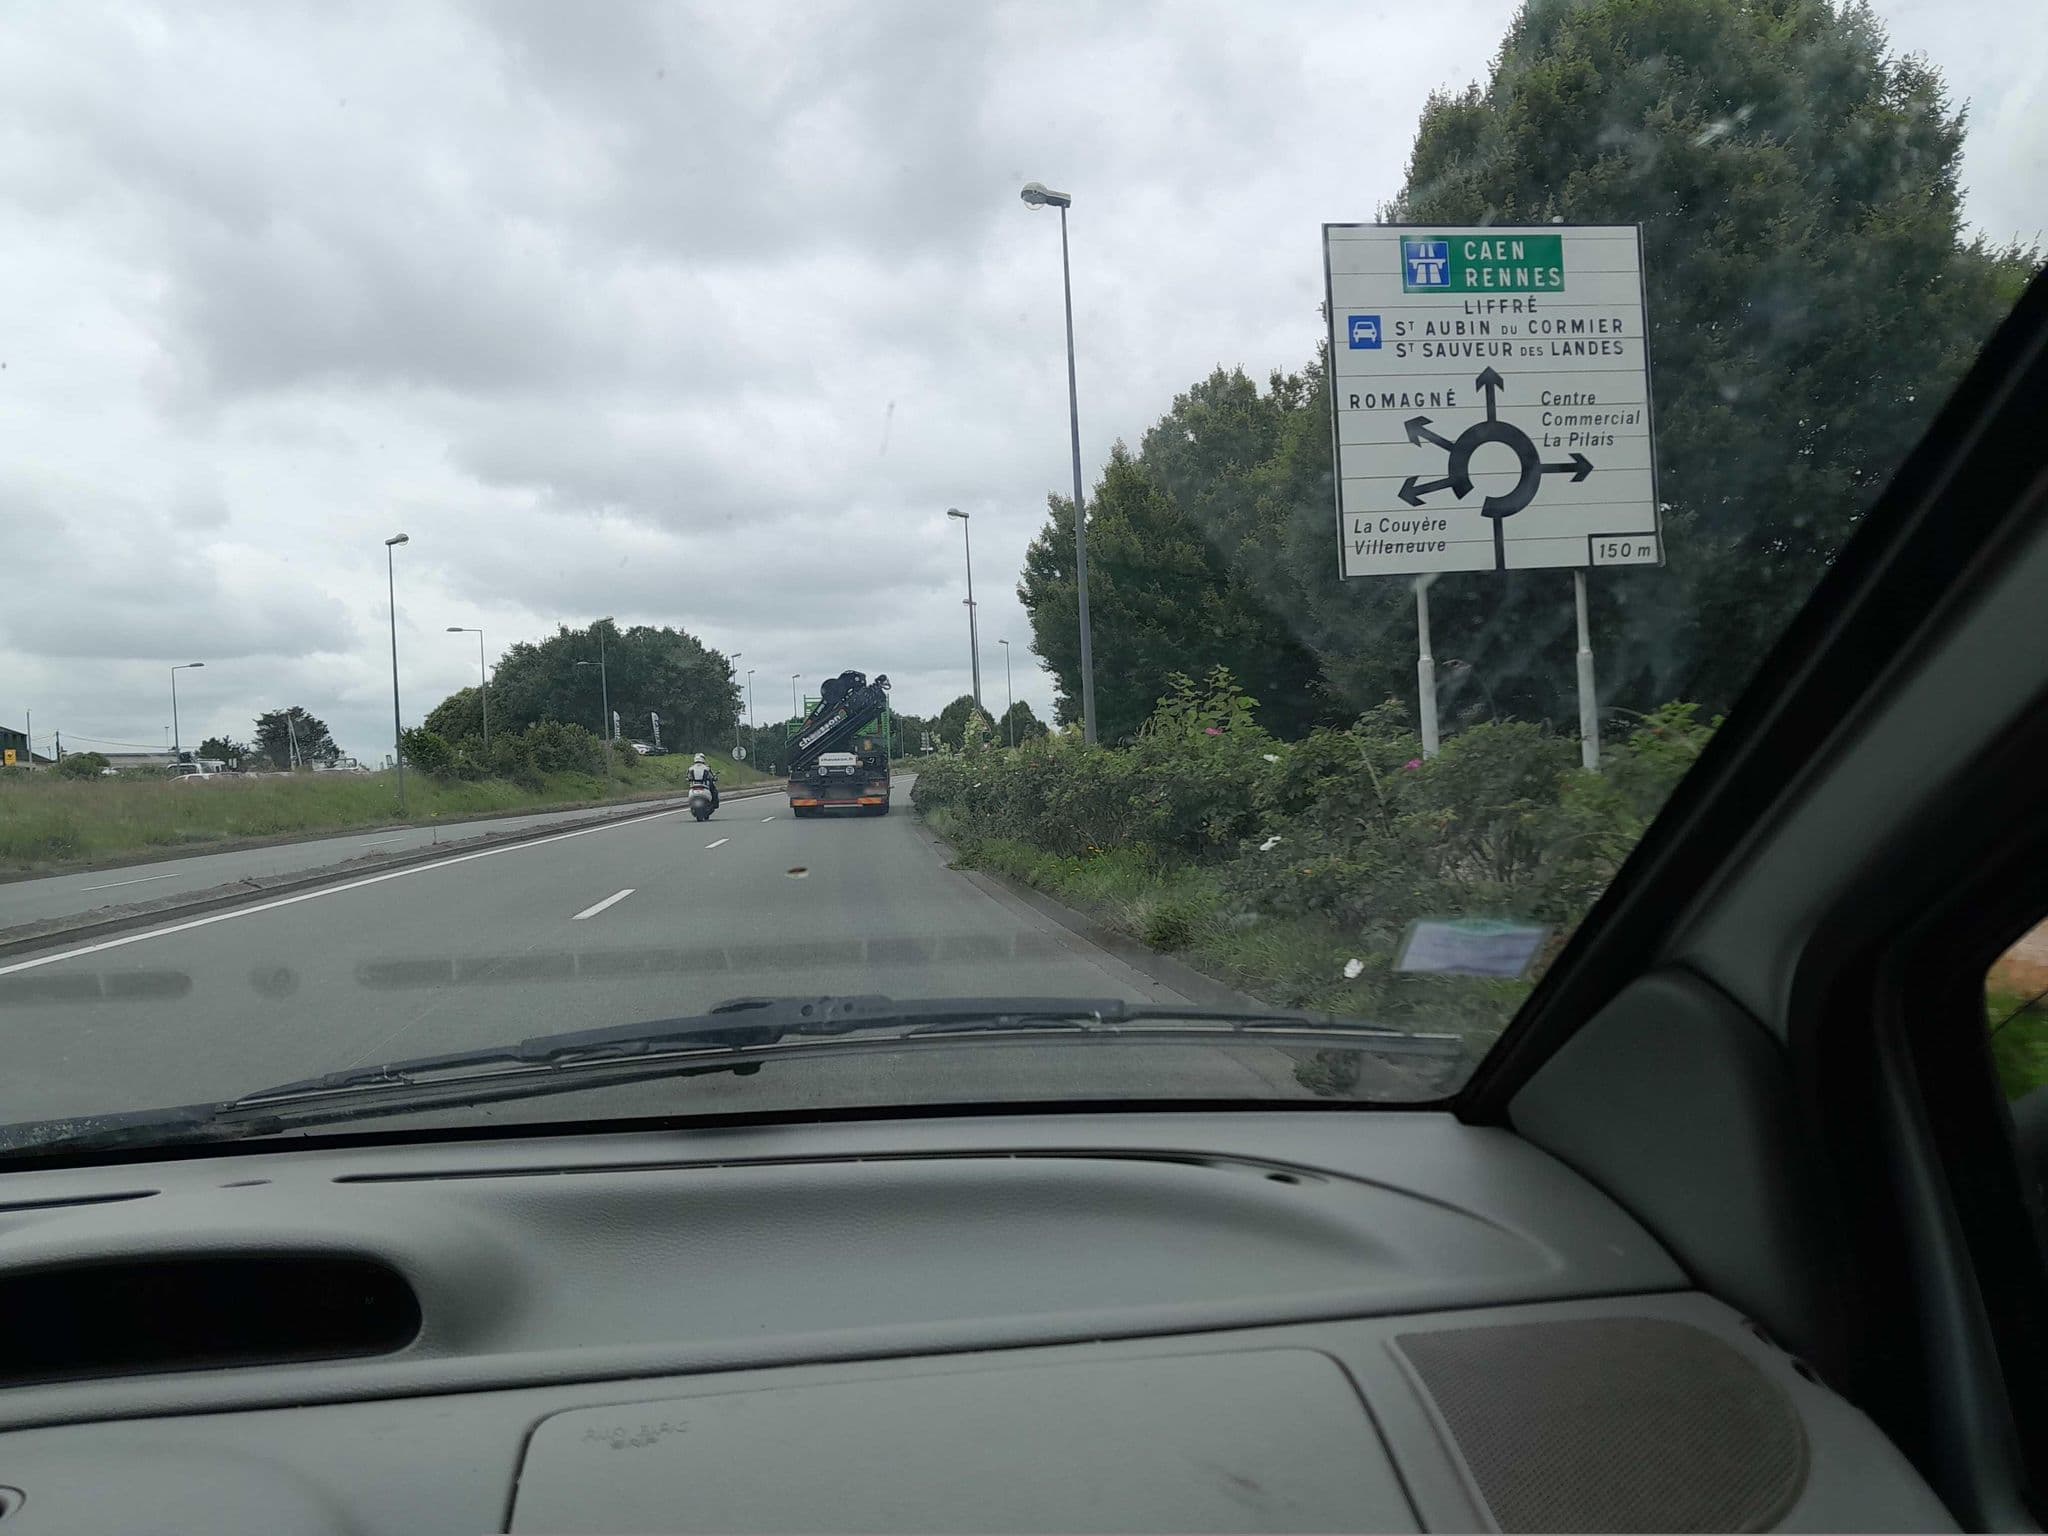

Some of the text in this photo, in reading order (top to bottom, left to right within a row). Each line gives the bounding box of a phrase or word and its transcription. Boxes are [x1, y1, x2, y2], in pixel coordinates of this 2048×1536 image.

[1464, 240, 1526, 261] CAEN
[1465, 266, 1562, 288] RENNES
[1464, 294, 1538, 315] LIFFRÉ
[1425, 320, 1491, 336] AUBIN
[1501, 324, 1519, 335] DU
[1528, 317, 1624, 335] CORMIER
[1422, 341, 1513, 358] SAUVEUR
[1520, 345, 1544, 356] DES
[1551, 340, 1625, 356] LANDES
[1349, 388, 1457, 409] ROMAGNÉ
[1541, 390, 1597, 406] Centre
[1542, 410, 1641, 427] Commercial
[1543, 431, 1615, 448] La Pilais
[1354, 515, 1448, 537] La Couyère
[1354, 539, 1447, 556] Villeneuve
[1598, 543, 1652, 559] 150 m
